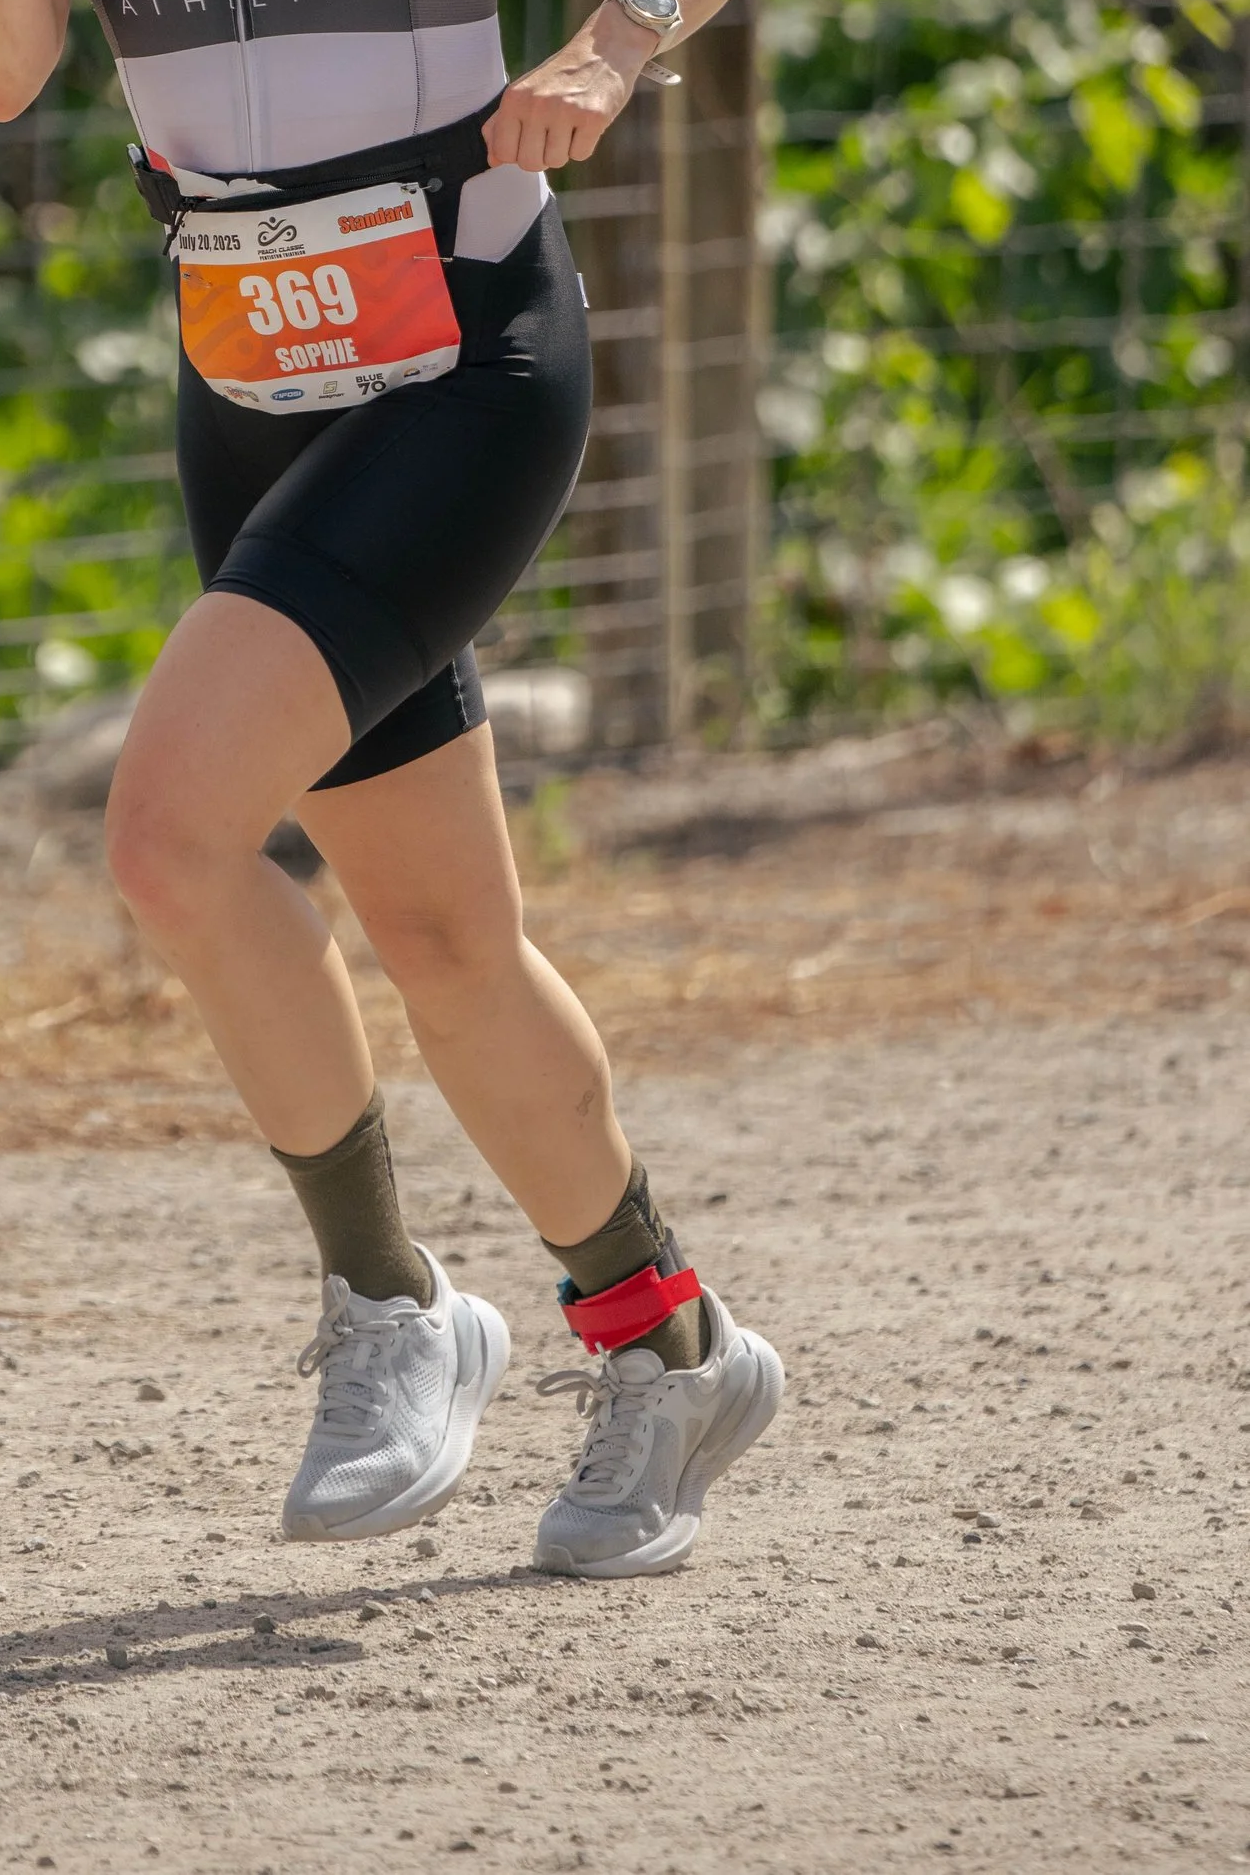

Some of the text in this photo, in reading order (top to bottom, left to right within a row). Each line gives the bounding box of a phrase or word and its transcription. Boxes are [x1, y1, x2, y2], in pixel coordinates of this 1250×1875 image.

[337, 200, 414, 234] Standard
[179, 233, 241, 252] July 20, 2025
[278, 244, 305, 253] CLASSIC
[239, 264, 358, 336] 369
[274, 337, 359, 373] SOPHIE
[355, 373, 384, 383] BLUE
[357, 380, 387, 396] 70
